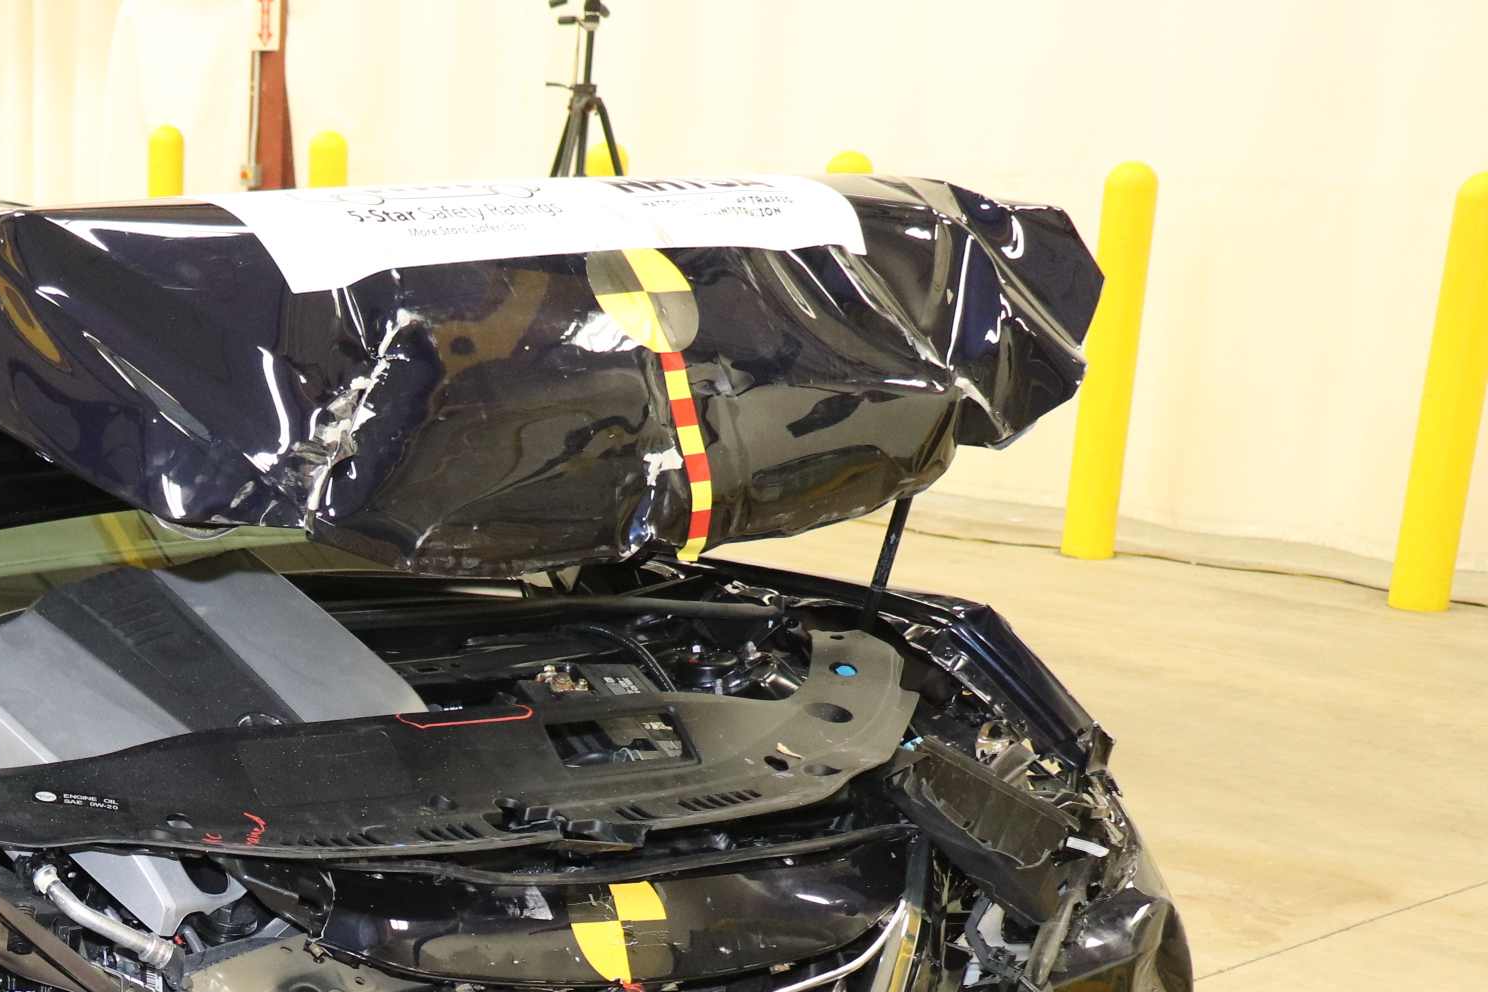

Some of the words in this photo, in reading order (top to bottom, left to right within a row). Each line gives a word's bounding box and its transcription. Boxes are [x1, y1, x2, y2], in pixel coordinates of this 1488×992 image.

[749, 194, 794, 205] TRAFFIC
[346, 209, 417, 223] 5-Star
[417, 205, 486, 221] Safety
[484, 202, 563, 217] Ratings
[408, 227, 438, 238] More
[438, 225, 470, 236] Stars.
[471, 223, 501, 234] Safer
[63, 793, 97, 802] ENGINE
[89, 802, 119, 811] 0W-20
